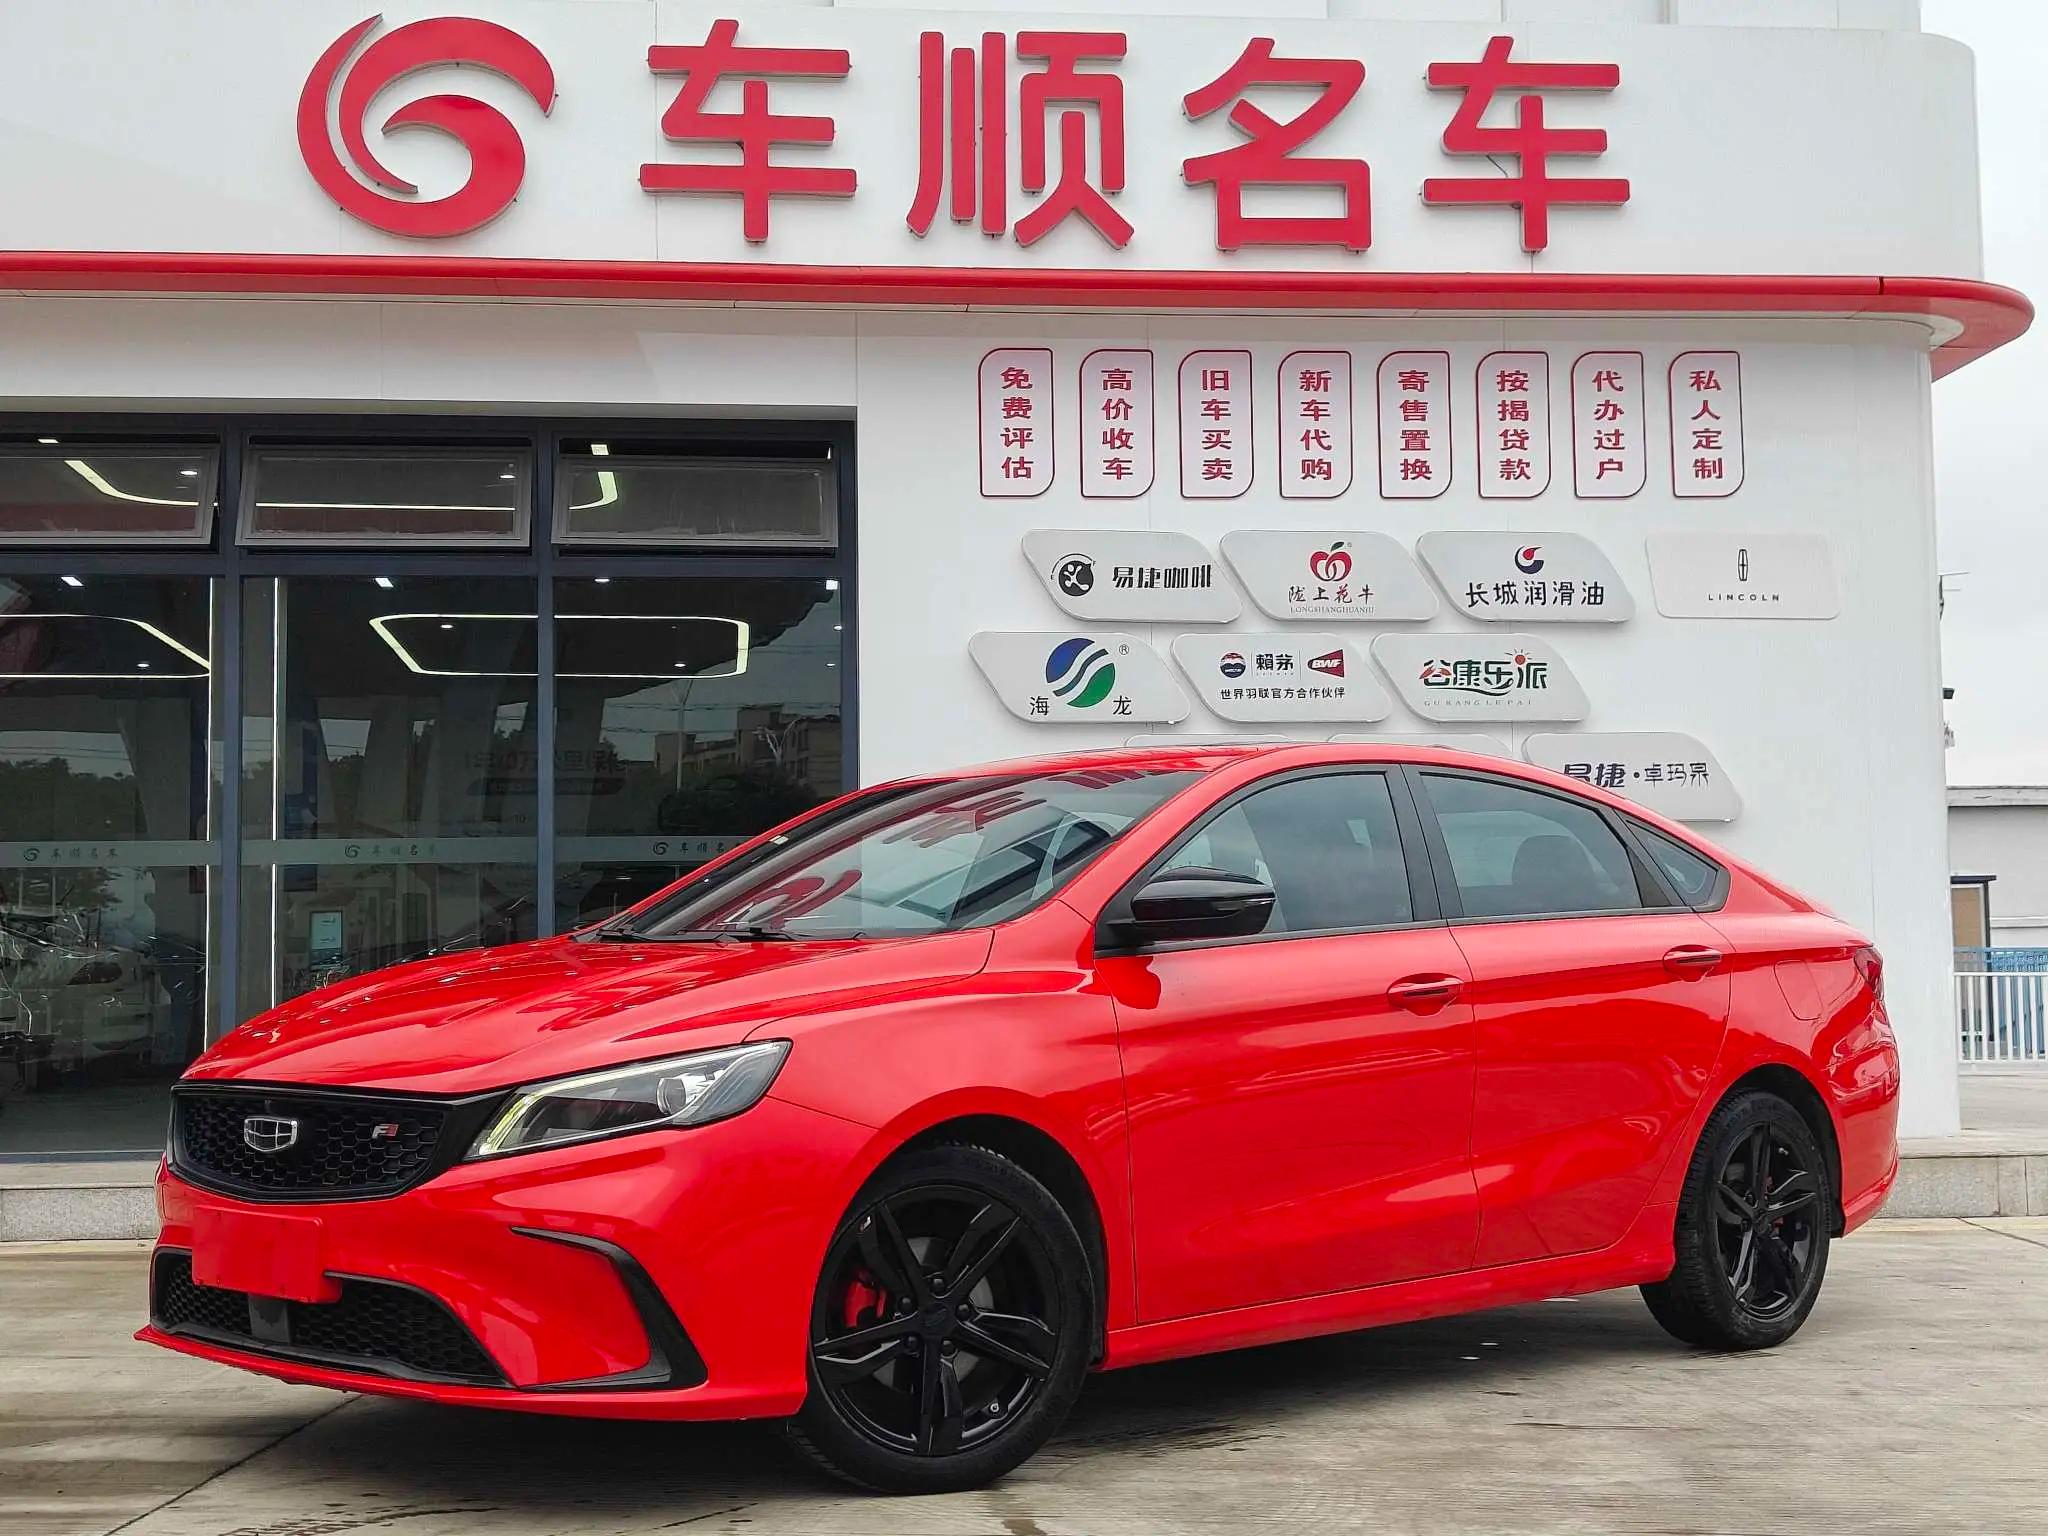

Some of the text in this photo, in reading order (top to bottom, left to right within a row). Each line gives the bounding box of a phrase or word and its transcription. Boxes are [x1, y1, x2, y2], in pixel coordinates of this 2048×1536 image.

[640, 18, 1630, 256] 车顺名车
[1000, 367, 1033, 479] 免费评估
[1101, 368, 1133, 480] 高价收车
[1200, 369, 1233, 481] 旧车买卖
[1299, 369, 1332, 481] 新车代购
[1397, 369, 1432, 481] 寄售置换
[1496, 369, 1531, 481] 按揭贷款
[1591, 369, 1624, 480] 代办过户
[1689, 369, 1723, 480] 私人定制
[1112, 563, 1212, 589] 易捷咖啡
[1288, 583, 1375, 605] 陇上花牛
[1465, 580, 1605, 608] 长城润滑油
[1708, 593, 1780, 601] LINCOLN
[1220, 687, 1346, 700] 世界羽联官方合作伙伴
[1311, 659, 1341, 669] BWF
[1420, 659, 1548, 689] 谷康乐派
